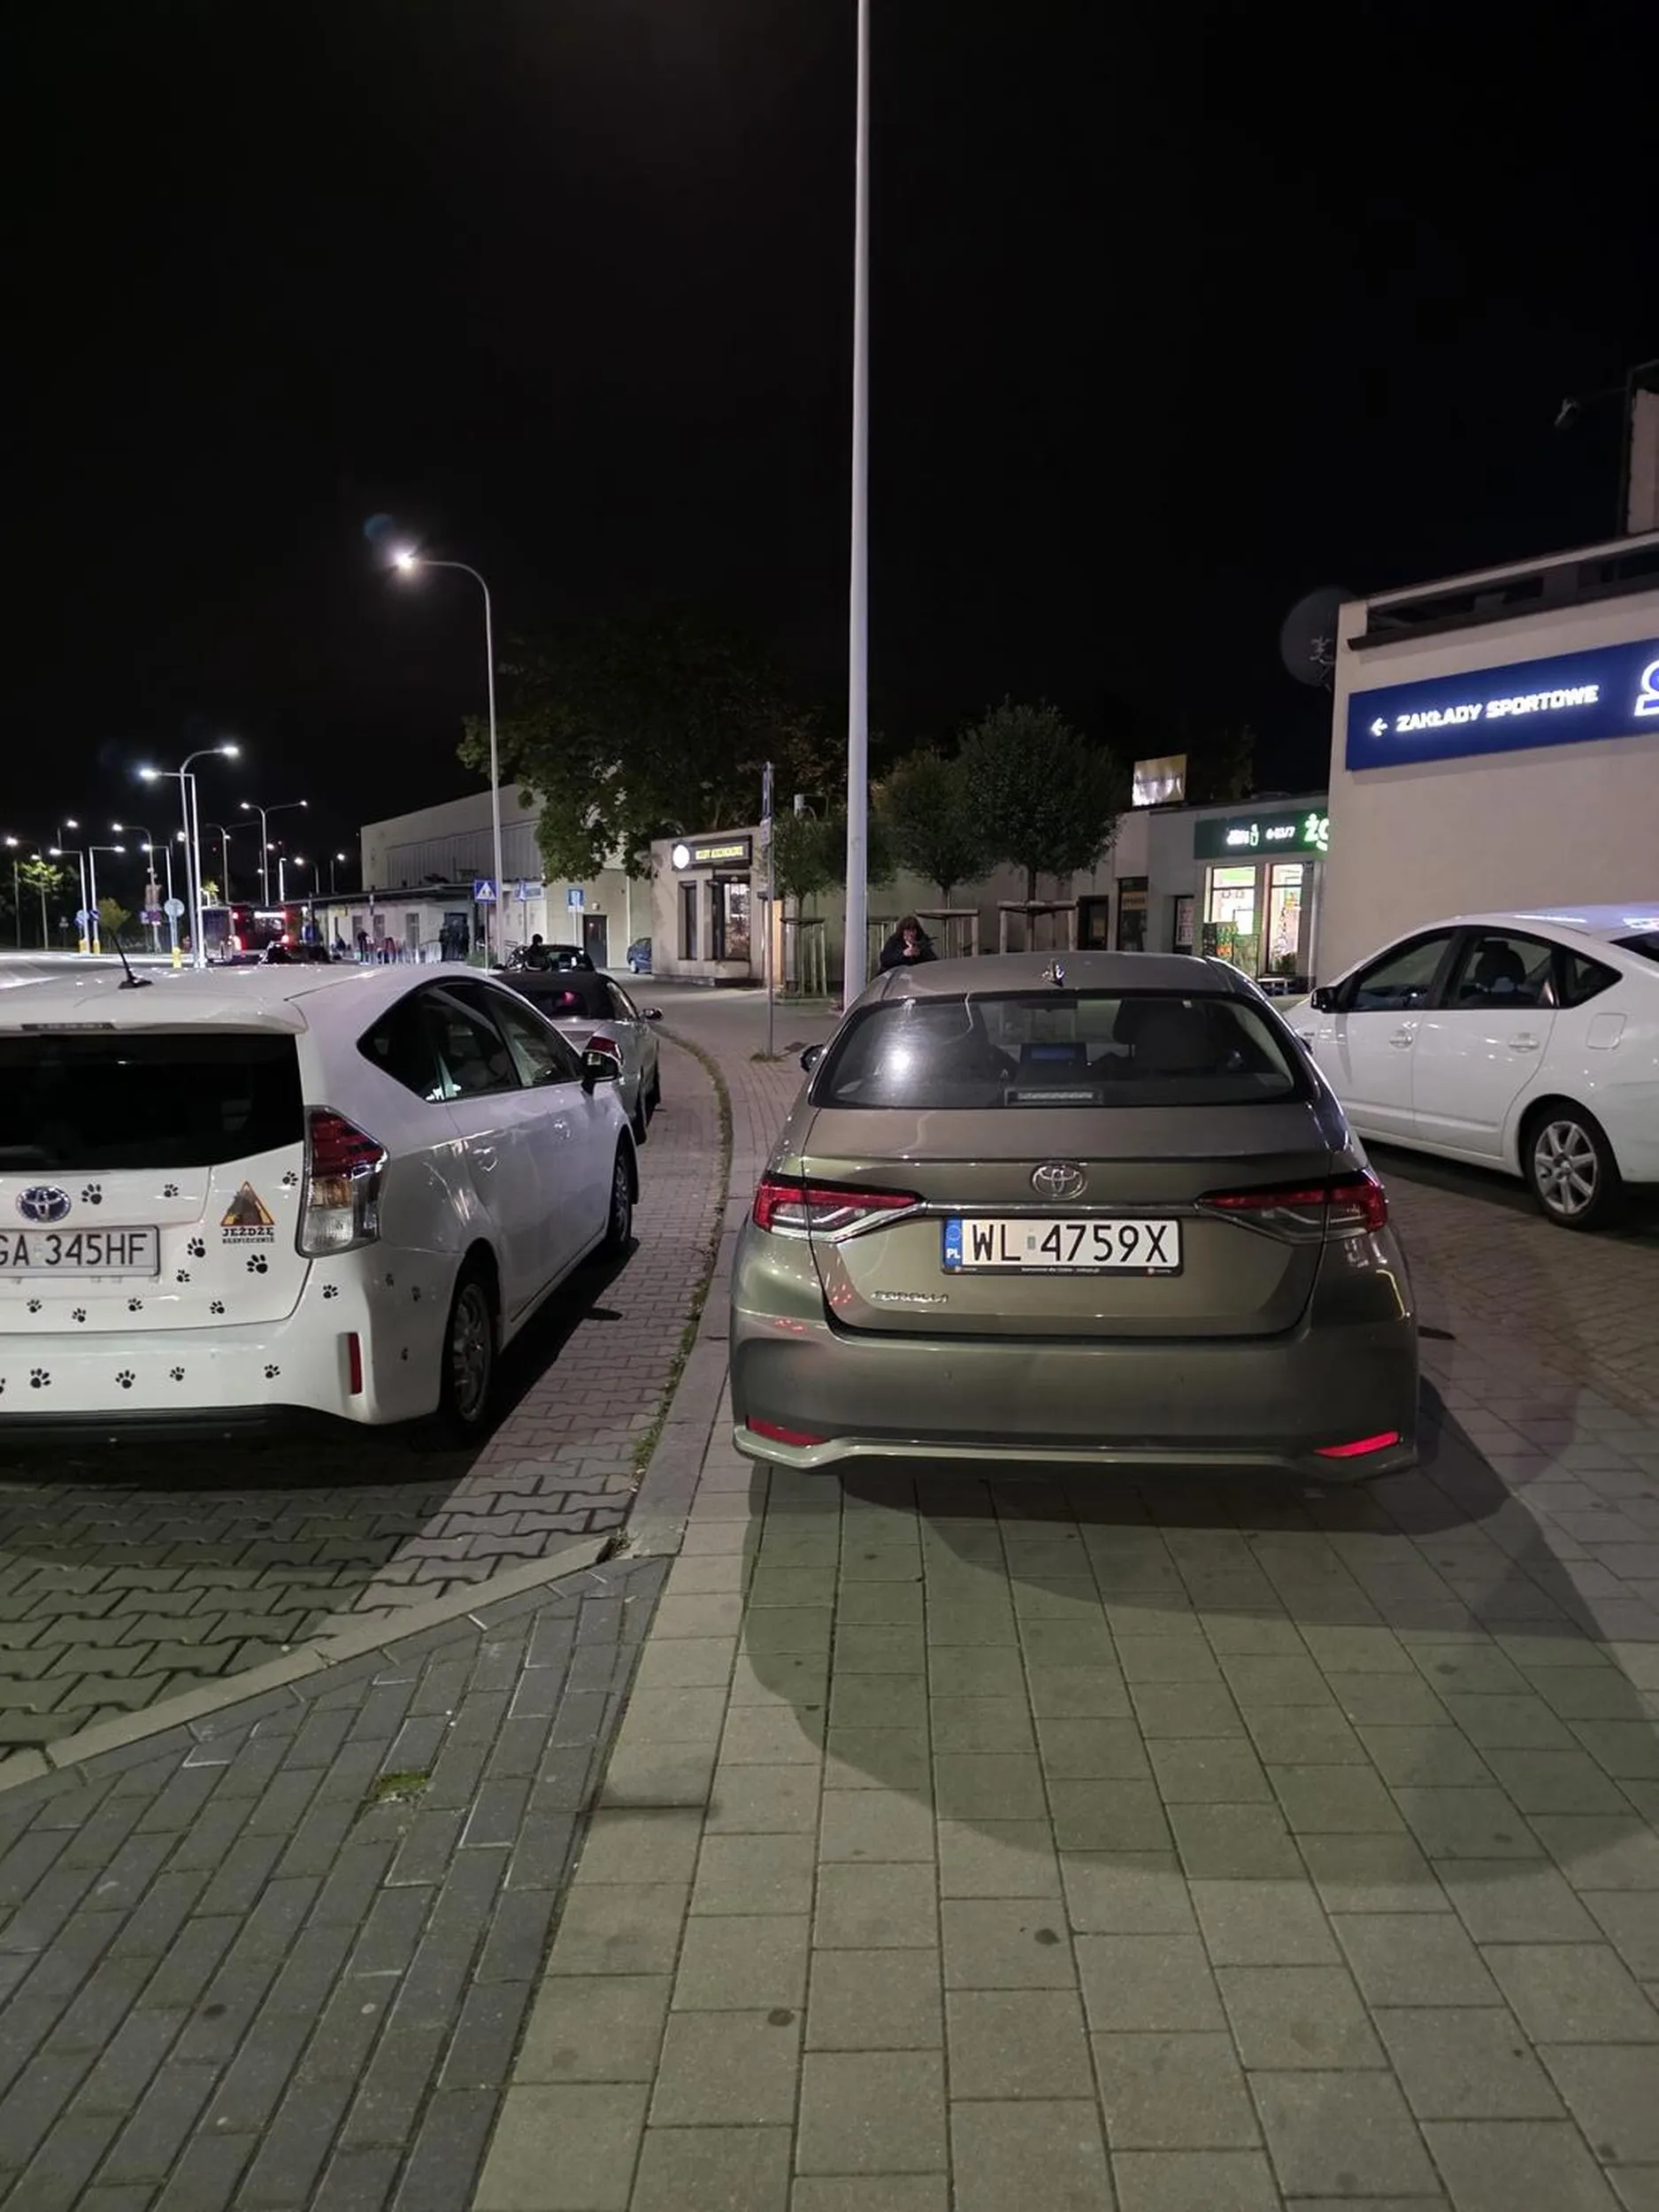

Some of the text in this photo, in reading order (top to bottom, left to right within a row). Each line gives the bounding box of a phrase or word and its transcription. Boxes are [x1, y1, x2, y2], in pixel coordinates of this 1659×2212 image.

[1396, 704, 1482, 732] ZAKŁADY
[1486, 685, 1599, 718] SPORTOWE
[45, 1233, 148, 1265] 345HF
[946, 1248, 961, 1259] PL
[972, 1224, 1168, 1263] WL 4759X
